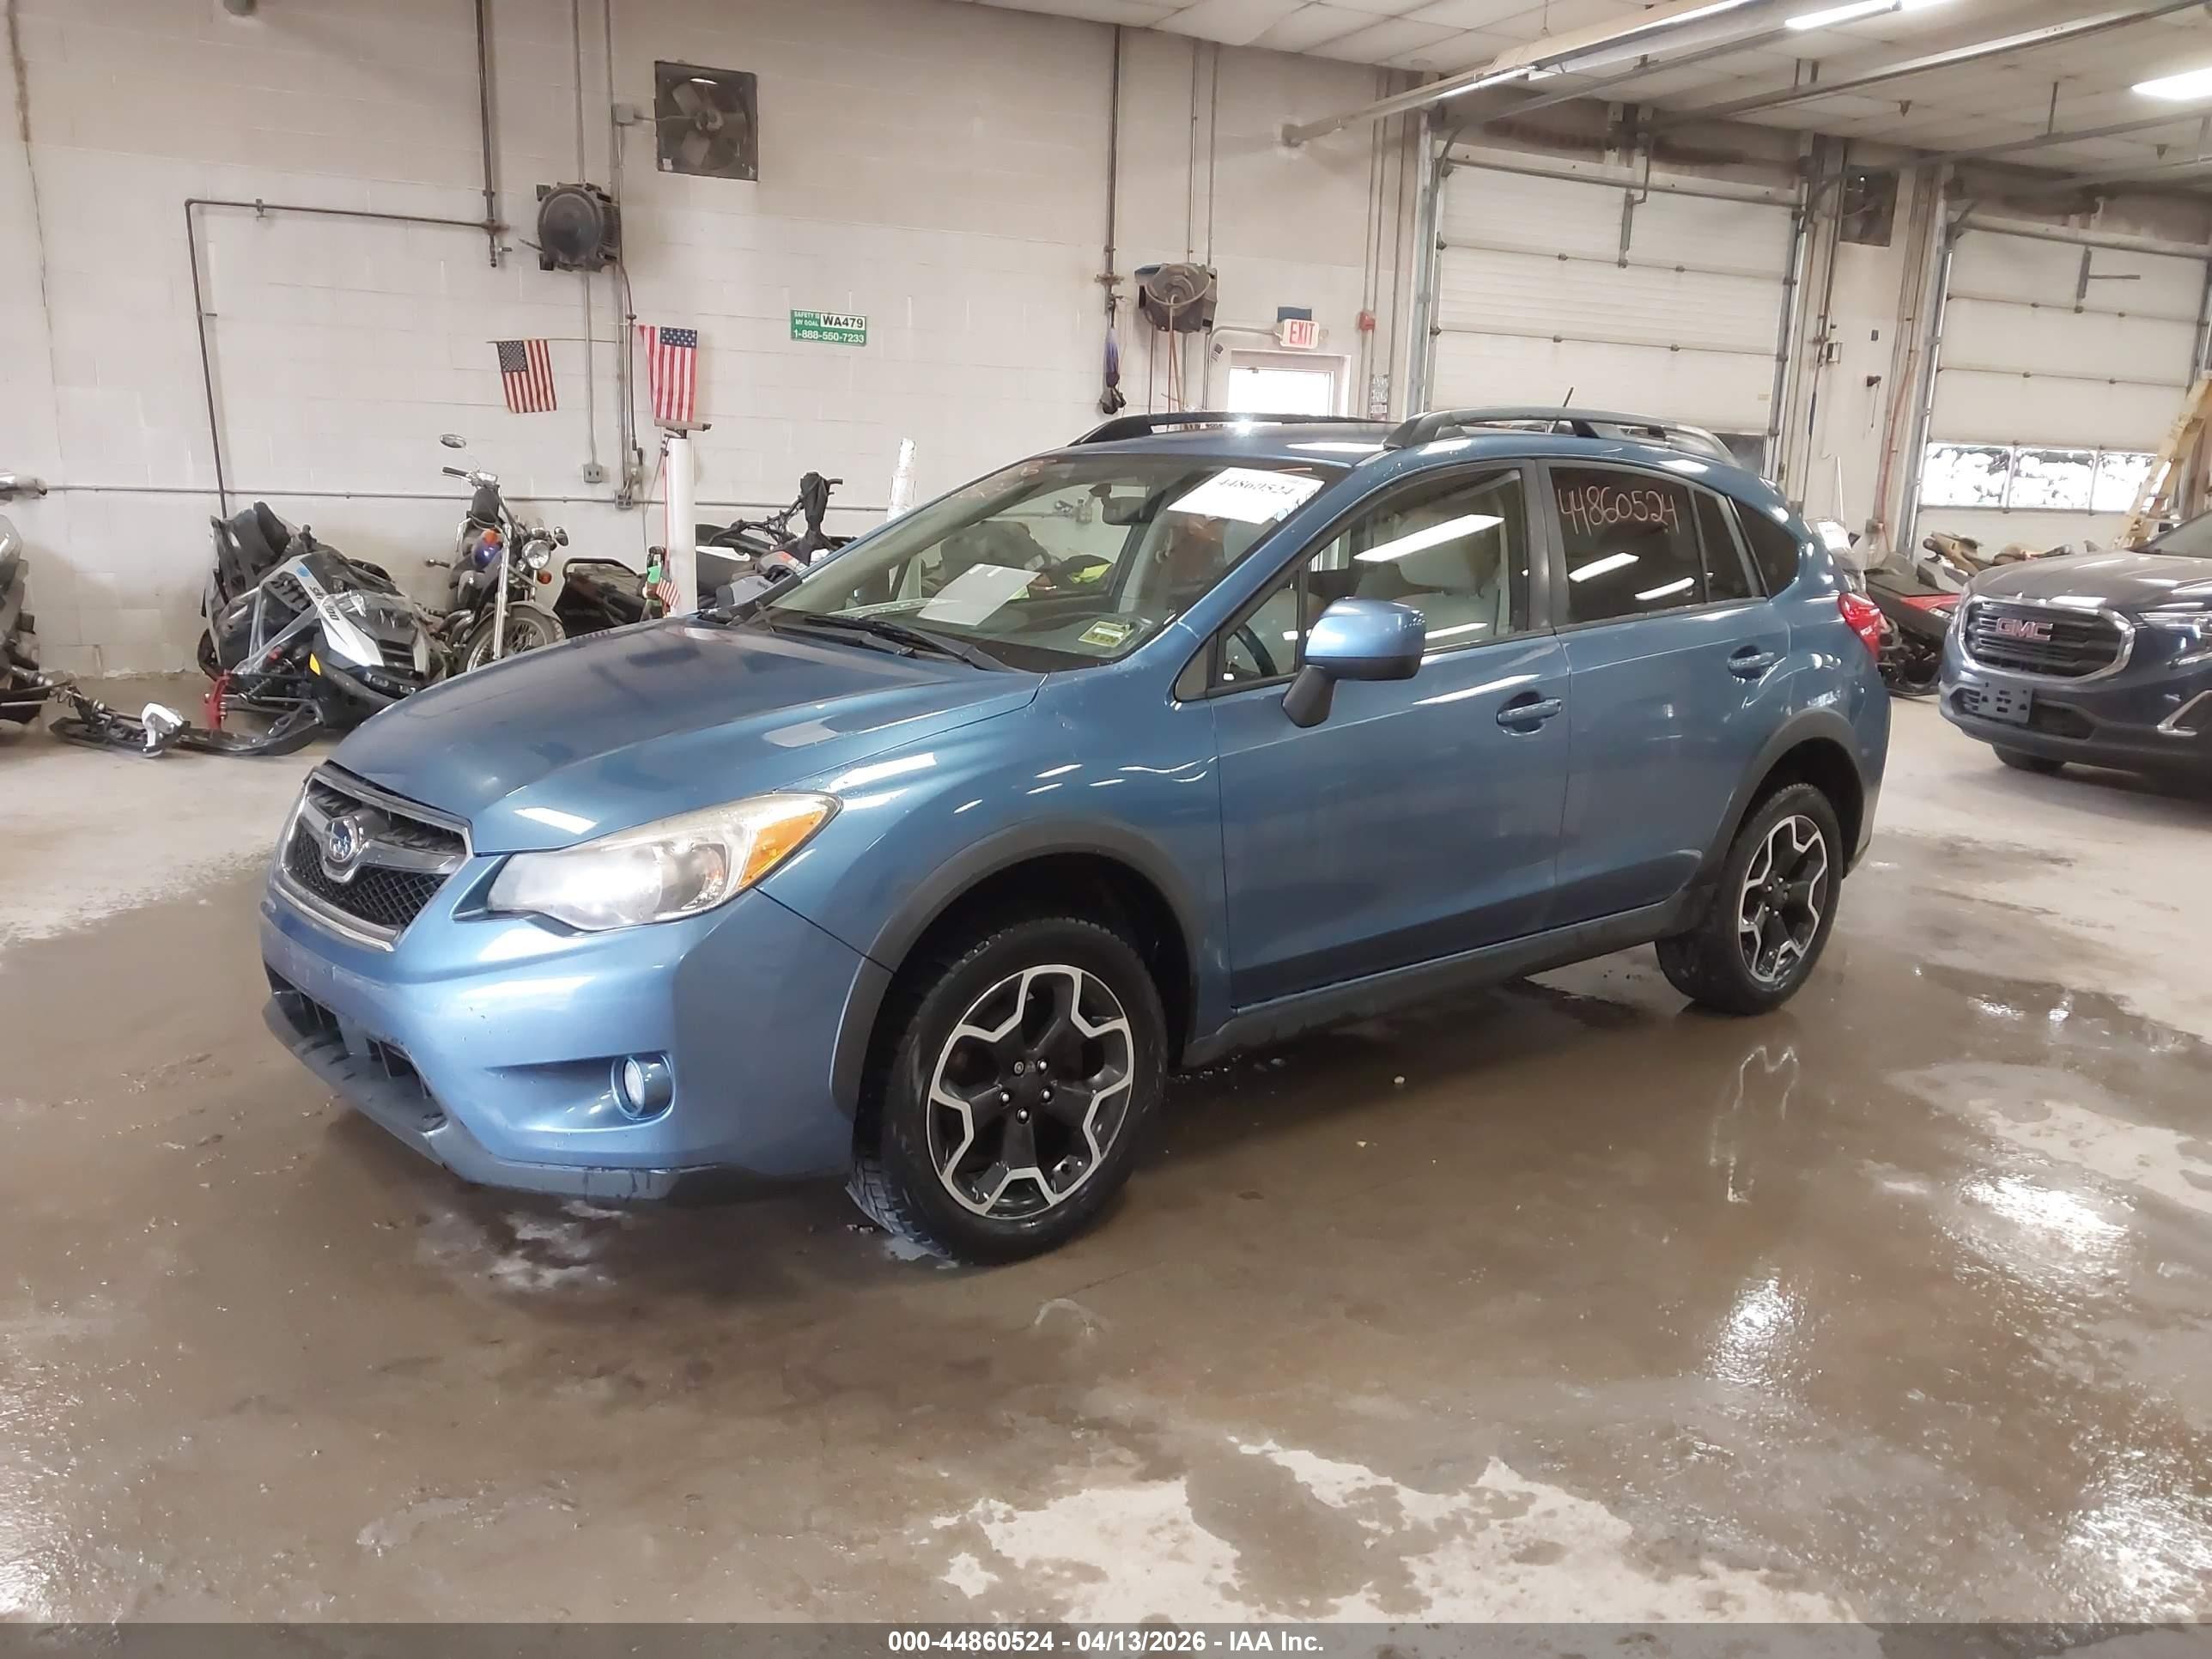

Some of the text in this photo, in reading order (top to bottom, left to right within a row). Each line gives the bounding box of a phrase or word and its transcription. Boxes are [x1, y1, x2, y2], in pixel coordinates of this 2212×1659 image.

[823, 315, 863, 328] WA479
[1290, 321, 1315, 344] EXIT
[1559, 486, 1680, 536] 44860524
[1996, 617, 2053, 641] GMC
